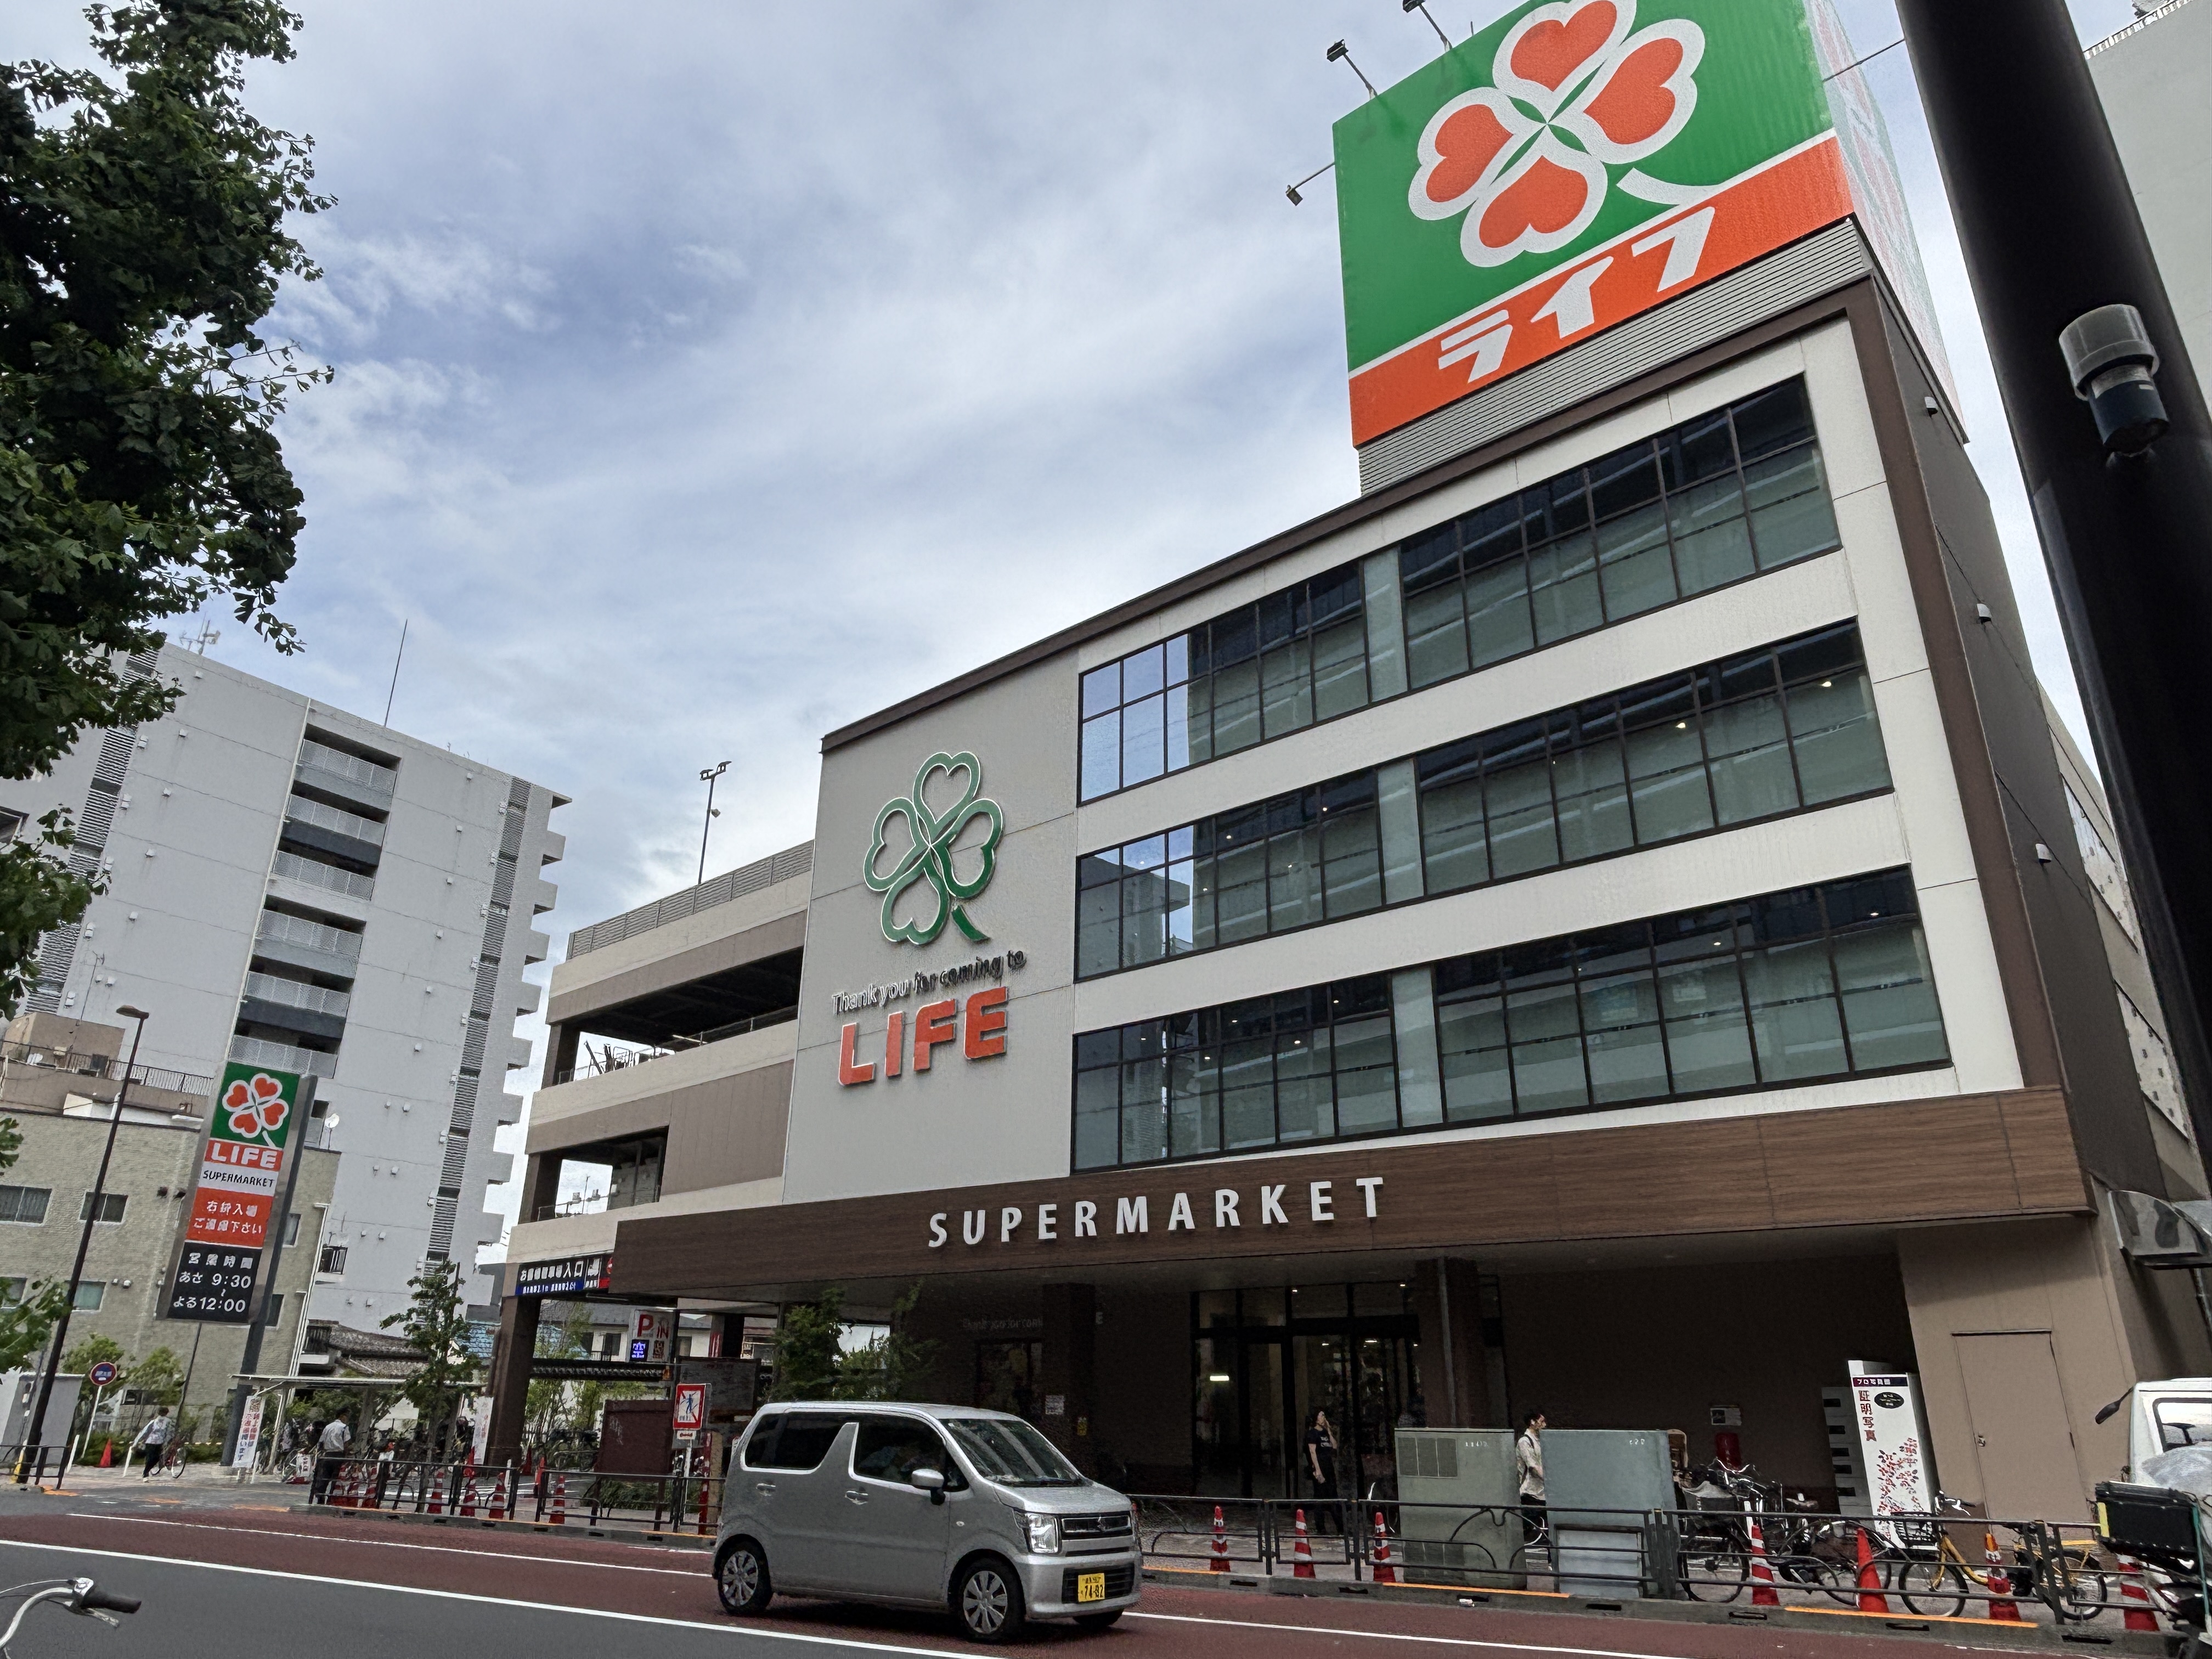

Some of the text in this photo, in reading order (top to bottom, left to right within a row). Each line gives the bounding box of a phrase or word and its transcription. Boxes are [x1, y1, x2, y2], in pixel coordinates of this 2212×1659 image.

[1437, 206, 1716, 384] ライフ
[831, 949, 1028, 1015] Thank you for coming to
[838, 986, 1009, 1086] LIFE
[211, 1143, 278, 1168] LIFE
[202, 1170, 275, 1188] SUPERMARKET
[928, 1176, 1384, 1248] SUPERMARKET
[179, 1271, 252, 1289] あさ 9:30
[173, 1296, 246, 1313] よる 12:00
[637, 1314, 654, 1337] P
